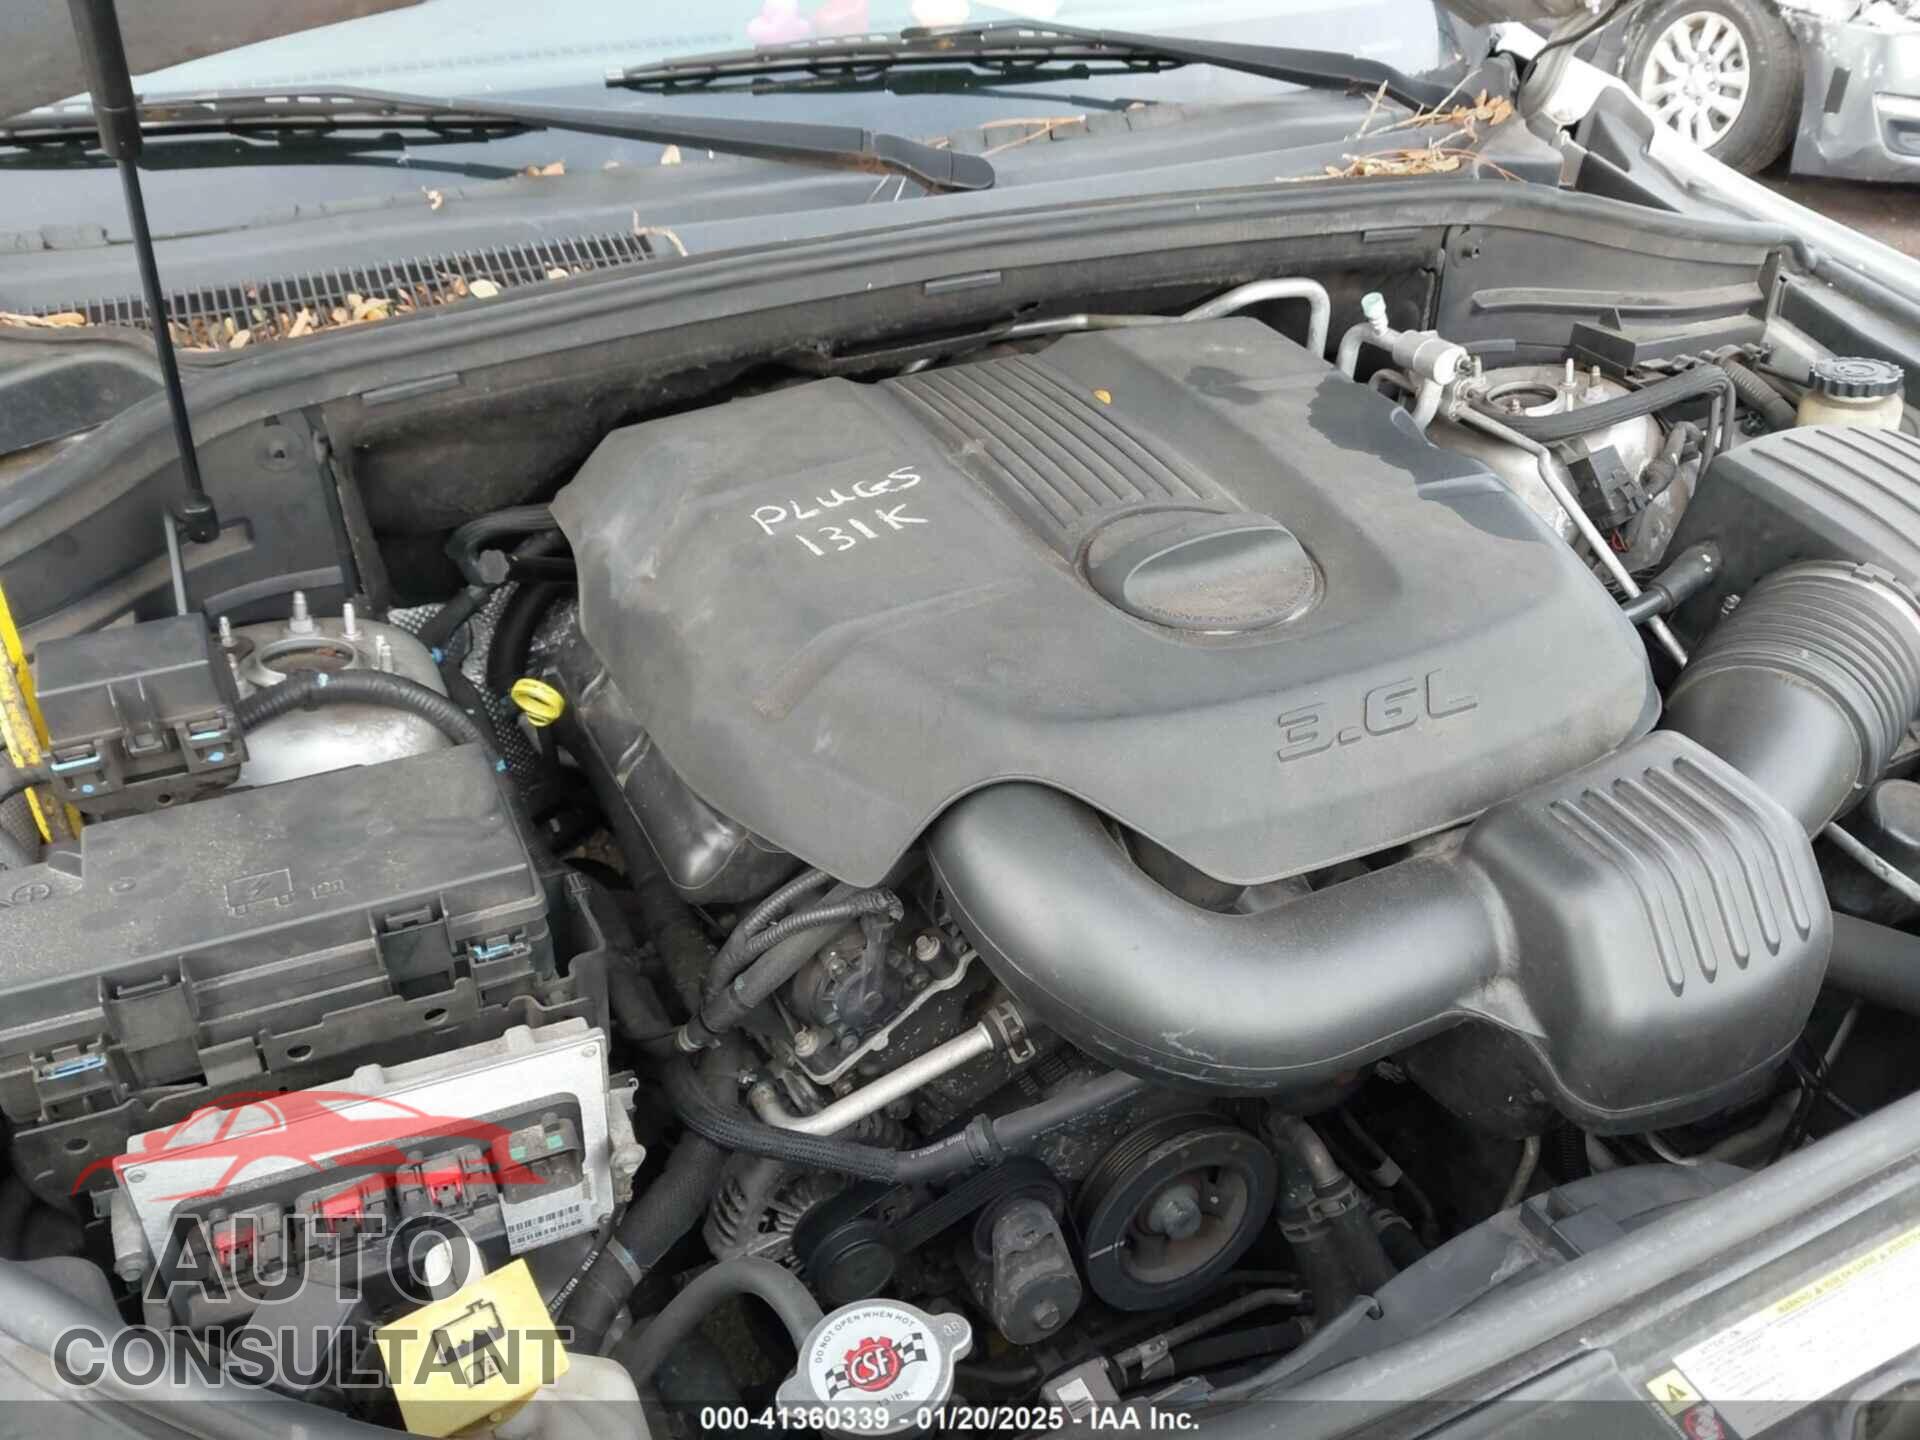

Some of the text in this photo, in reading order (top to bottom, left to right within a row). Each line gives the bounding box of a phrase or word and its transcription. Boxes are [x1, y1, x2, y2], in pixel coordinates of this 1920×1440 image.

[749, 465, 921, 536] PLUGS
[795, 503, 929, 556] 131K
[1276, 667, 1479, 763] 3.6L
[815, 1310, 915, 1364] DO NOT OPEN WHEN HOT
[851, 1347, 890, 1384] CSF
